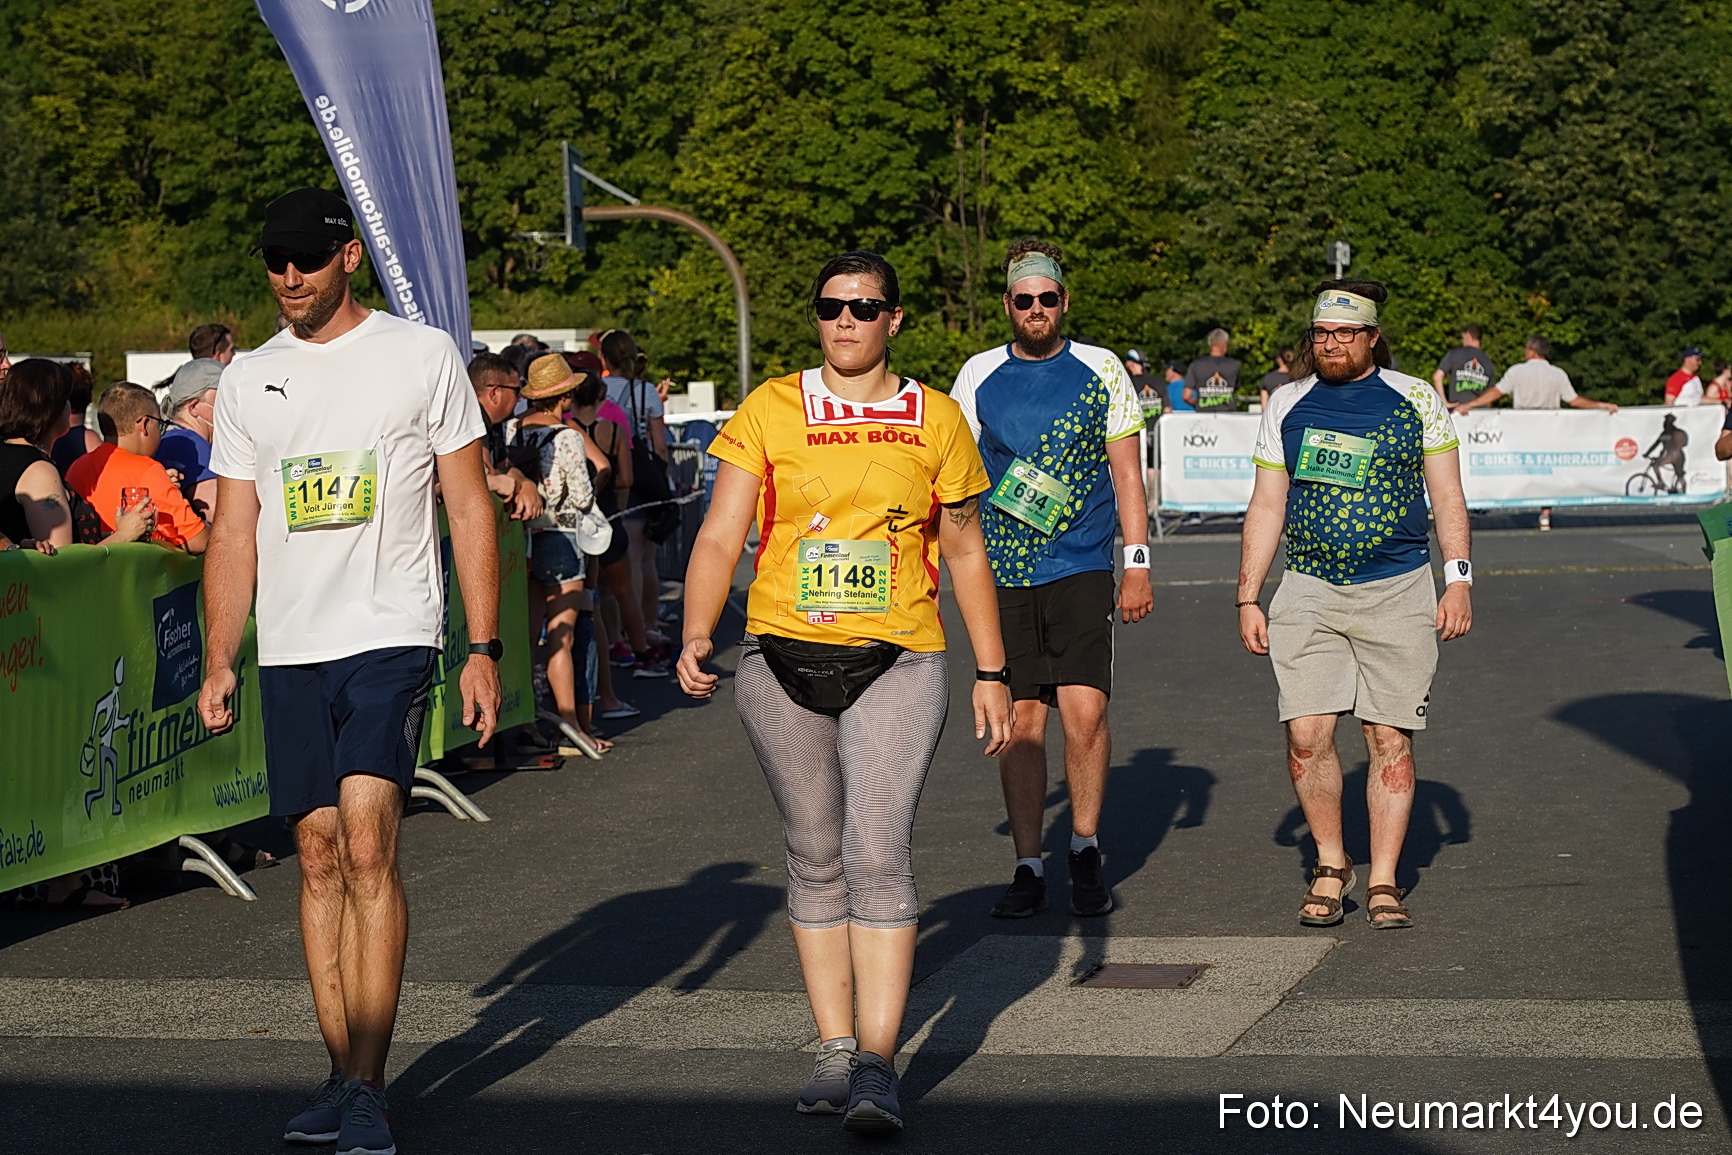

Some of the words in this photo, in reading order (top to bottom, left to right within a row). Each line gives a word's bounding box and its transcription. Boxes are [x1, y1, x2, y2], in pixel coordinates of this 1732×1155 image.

[807, 432, 860, 446] MAX
[868, 426, 926, 448] BÖGL
[1184, 434, 1218, 446] NOW
[1468, 432, 1502, 444] NOW
[1186, 458, 1236, 469] E-BIKES
[1300, 452, 1310, 470] RUN
[1316, 448, 1352, 469] 693
[1356, 458, 1368, 481] 2022
[1472, 454, 1522, 466] E-BIKES
[1525, 454, 1534, 464] &
[1538, 452, 1616, 464] FAHRRÄDER
[1326, 467, 1356, 478] Raimund
[298, 476, 360, 503] 1147
[998, 480, 1011, 496] RUN
[1014, 481, 1049, 510] 694
[288, 486, 297, 520] WALK
[304, 504, 320, 513] Voit
[322, 502, 354, 512] Jürgen
[1045, 504, 1060, 527] 2022
[802, 567, 810, 600] WALK
[812, 564, 876, 588] 1148
[878, 570, 886, 602] 2022
[809, 590, 841, 599] Nehring
[844, 590, 878, 598] Stefanie
[164, 622, 192, 650] Fischer
[129, 757, 184, 804] neumarkt
